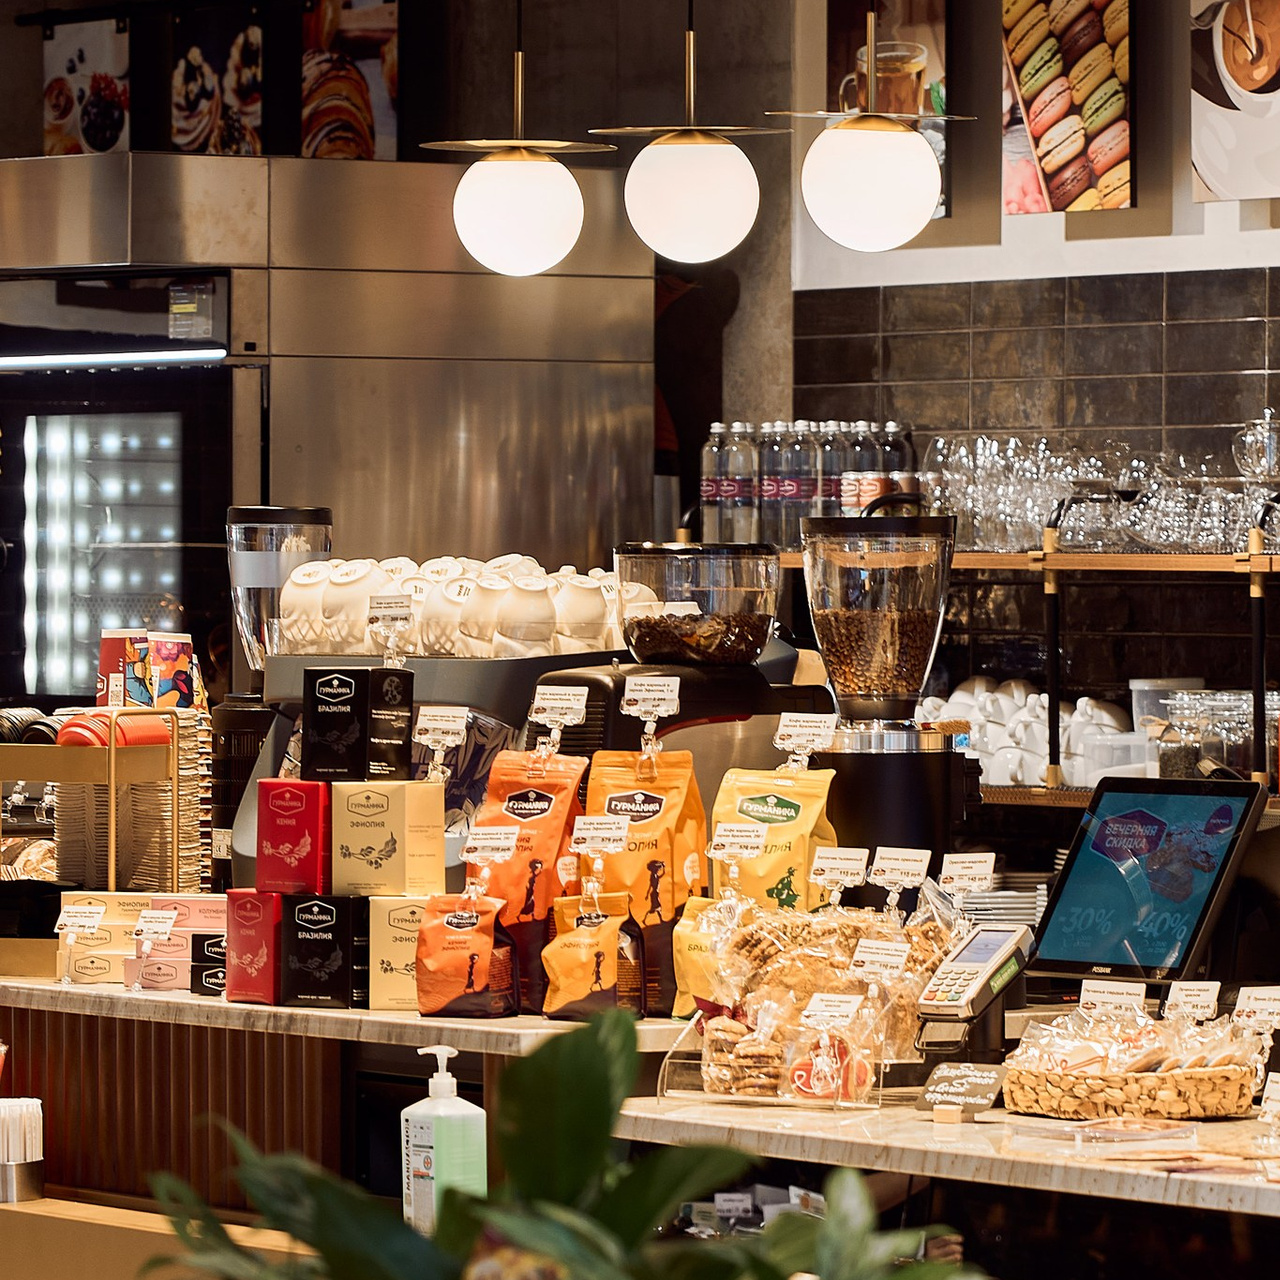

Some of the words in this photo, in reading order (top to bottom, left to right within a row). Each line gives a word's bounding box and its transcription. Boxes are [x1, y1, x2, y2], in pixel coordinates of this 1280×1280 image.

[318, 705, 351, 713] БРАЗИЛИЯ
[611, 801, 660, 811] ГУРМАНИКА
[743, 802, 796, 817] ГУРМАНИКА
[276, 818, 297, 826] КЕНИЯ
[350, 821, 385, 829] ЭФИОПИЯ
[1105, 823, 1159, 837] ВЕЧЕРНЯЯ
[1105, 837, 1148, 849] СКИДКА
[299, 913, 332, 921] ГУРМАНИКА
[298, 931, 333, 940] БРАЗИЛИЯ
